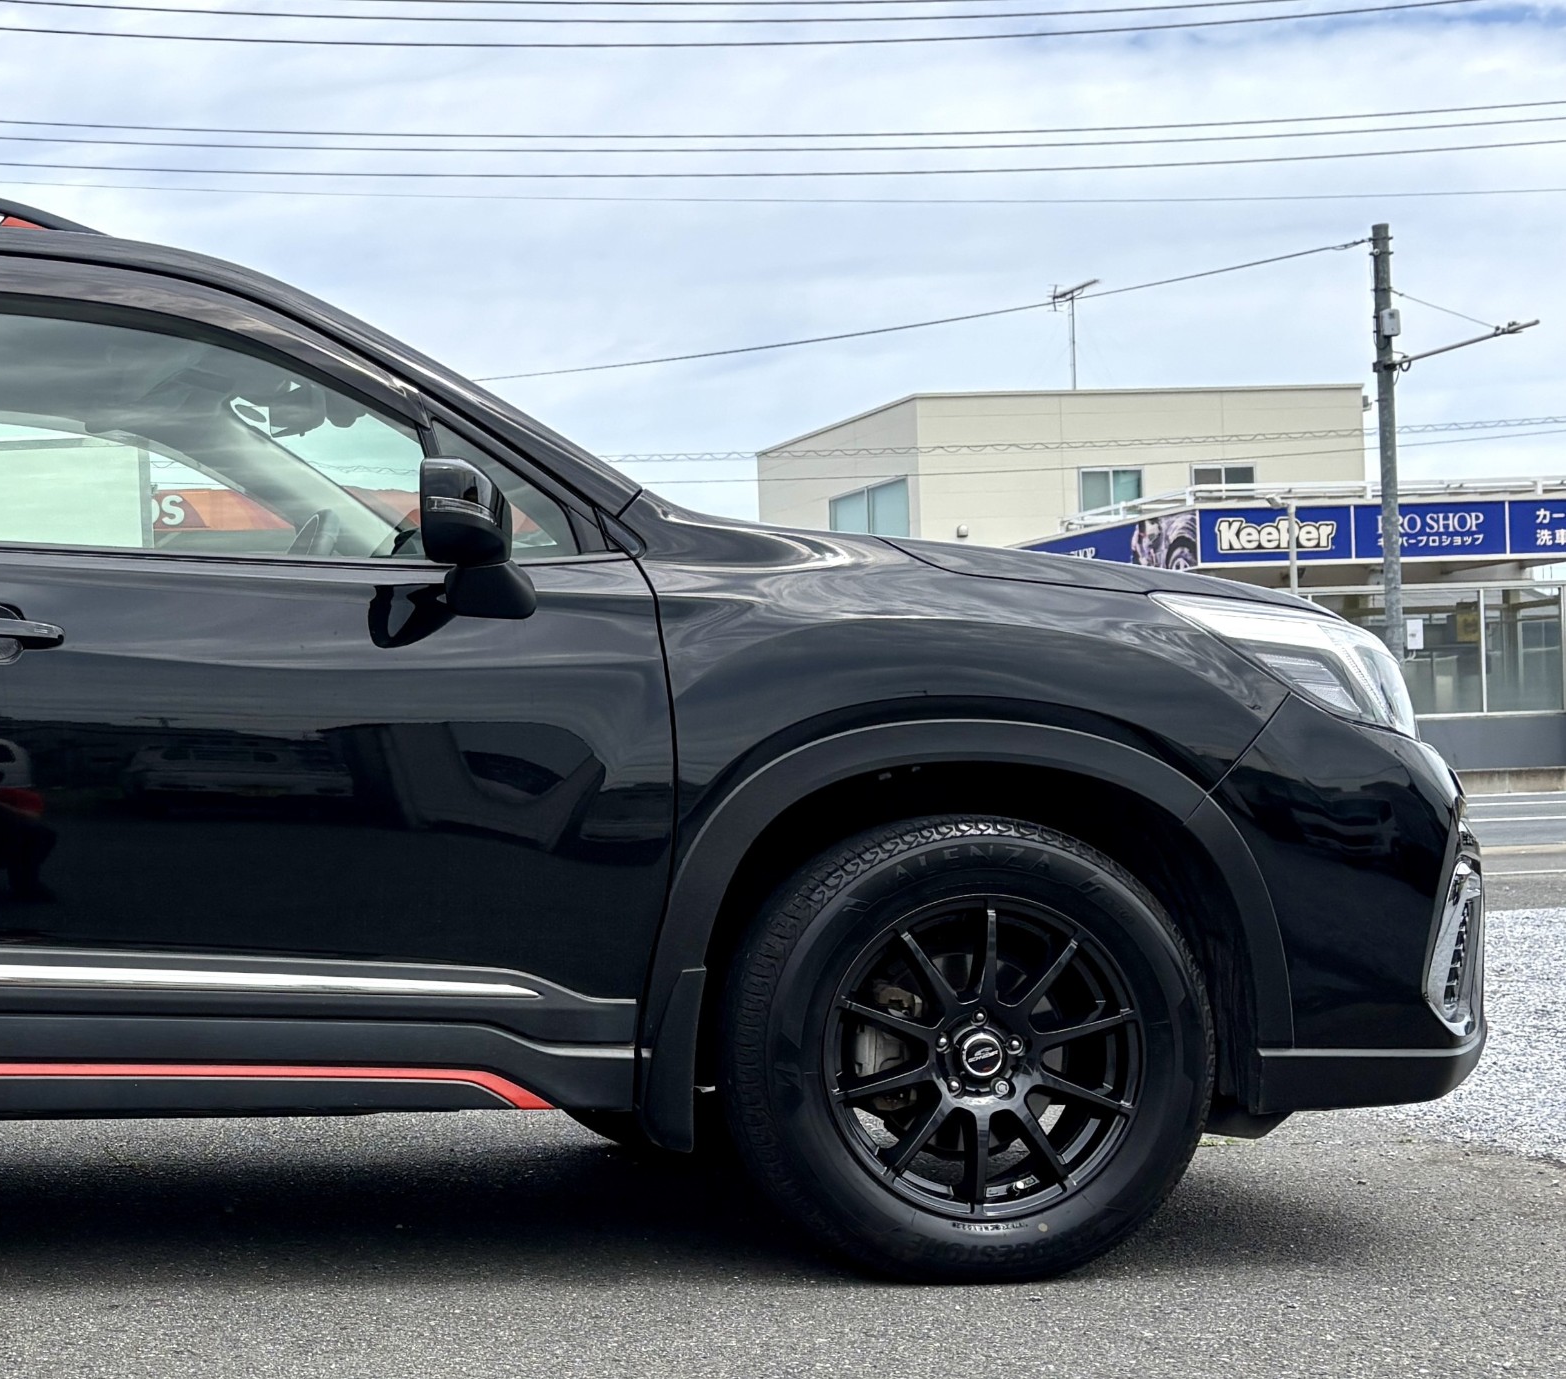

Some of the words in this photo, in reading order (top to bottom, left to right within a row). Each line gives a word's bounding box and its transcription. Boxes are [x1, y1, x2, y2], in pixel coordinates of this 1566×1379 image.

[1425, 511, 1485, 534] SHOP
[1377, 534, 1485, 548] キパープロショップ
[1536, 528, 1566, 546] 洗車
